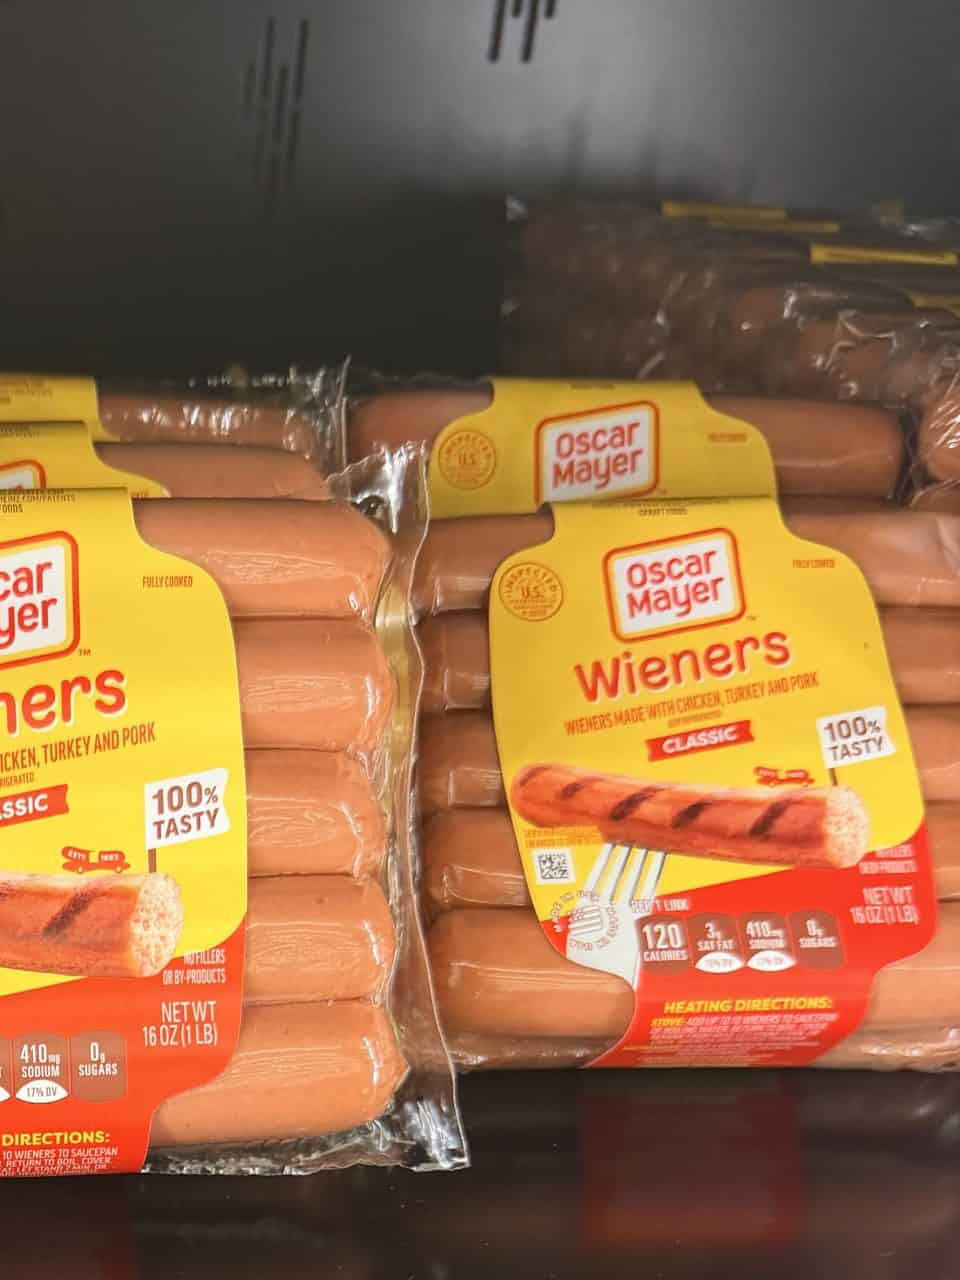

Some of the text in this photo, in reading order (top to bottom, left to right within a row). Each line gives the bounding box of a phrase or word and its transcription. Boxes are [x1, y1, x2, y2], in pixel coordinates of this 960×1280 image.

[555, 421, 641, 460] Oscar
[552, 448, 644, 490] Mayer
[626, 550, 717, 590] Oscar
[626, 575, 725, 619] Mayer
[573, 631, 791, 704] Wieners
[564, 713, 613, 737] WIENERS
[613, 706, 646, 728] MADE
[647, 700, 675, 721] WITH
[725, 683, 766, 706] TURKEY
[767, 679, 789, 697] AND
[790, 671, 818, 693] PORK
[661, 725, 738, 755] CLASSIC
[823, 715, 881, 743] 100%
[41, 737, 91, 766] TURKEY
[93, 729, 120, 754] AND
[122, 721, 156, 748] PORK
[828, 735, 884, 762] TASTY
[152, 780, 219, 816] 100%
[152, 807, 219, 840] TASTY
[863, 885, 913, 905] NET WT
[642, 923, 683, 949] 120
[697, 940, 716, 951] SAT
[643, 951, 688, 962] CALORIES
[161, 1000, 217, 1023] NET WT
[664, 996, 833, 1014] HEATING DIRECTIONS:
[143, 1023, 218, 1047] 16 OZ (1 LB)
[20, 1044, 61, 1066] 410mg
[90, 1042, 106, 1063] 0g
[21, 1064, 60, 1078] SODIUM
[78, 1063, 118, 1077] SUGARS
[26, 1086, 57, 1098] 17% DV
[2, 1131, 110, 1147] DIRECTIONS:
[3, 1150, 12, 1161] 10
[15, 1149, 56, 1160] WIENERS
[58, 1148, 69, 1158] TO
[71, 1147, 119, 1158] SAUCEPAN
